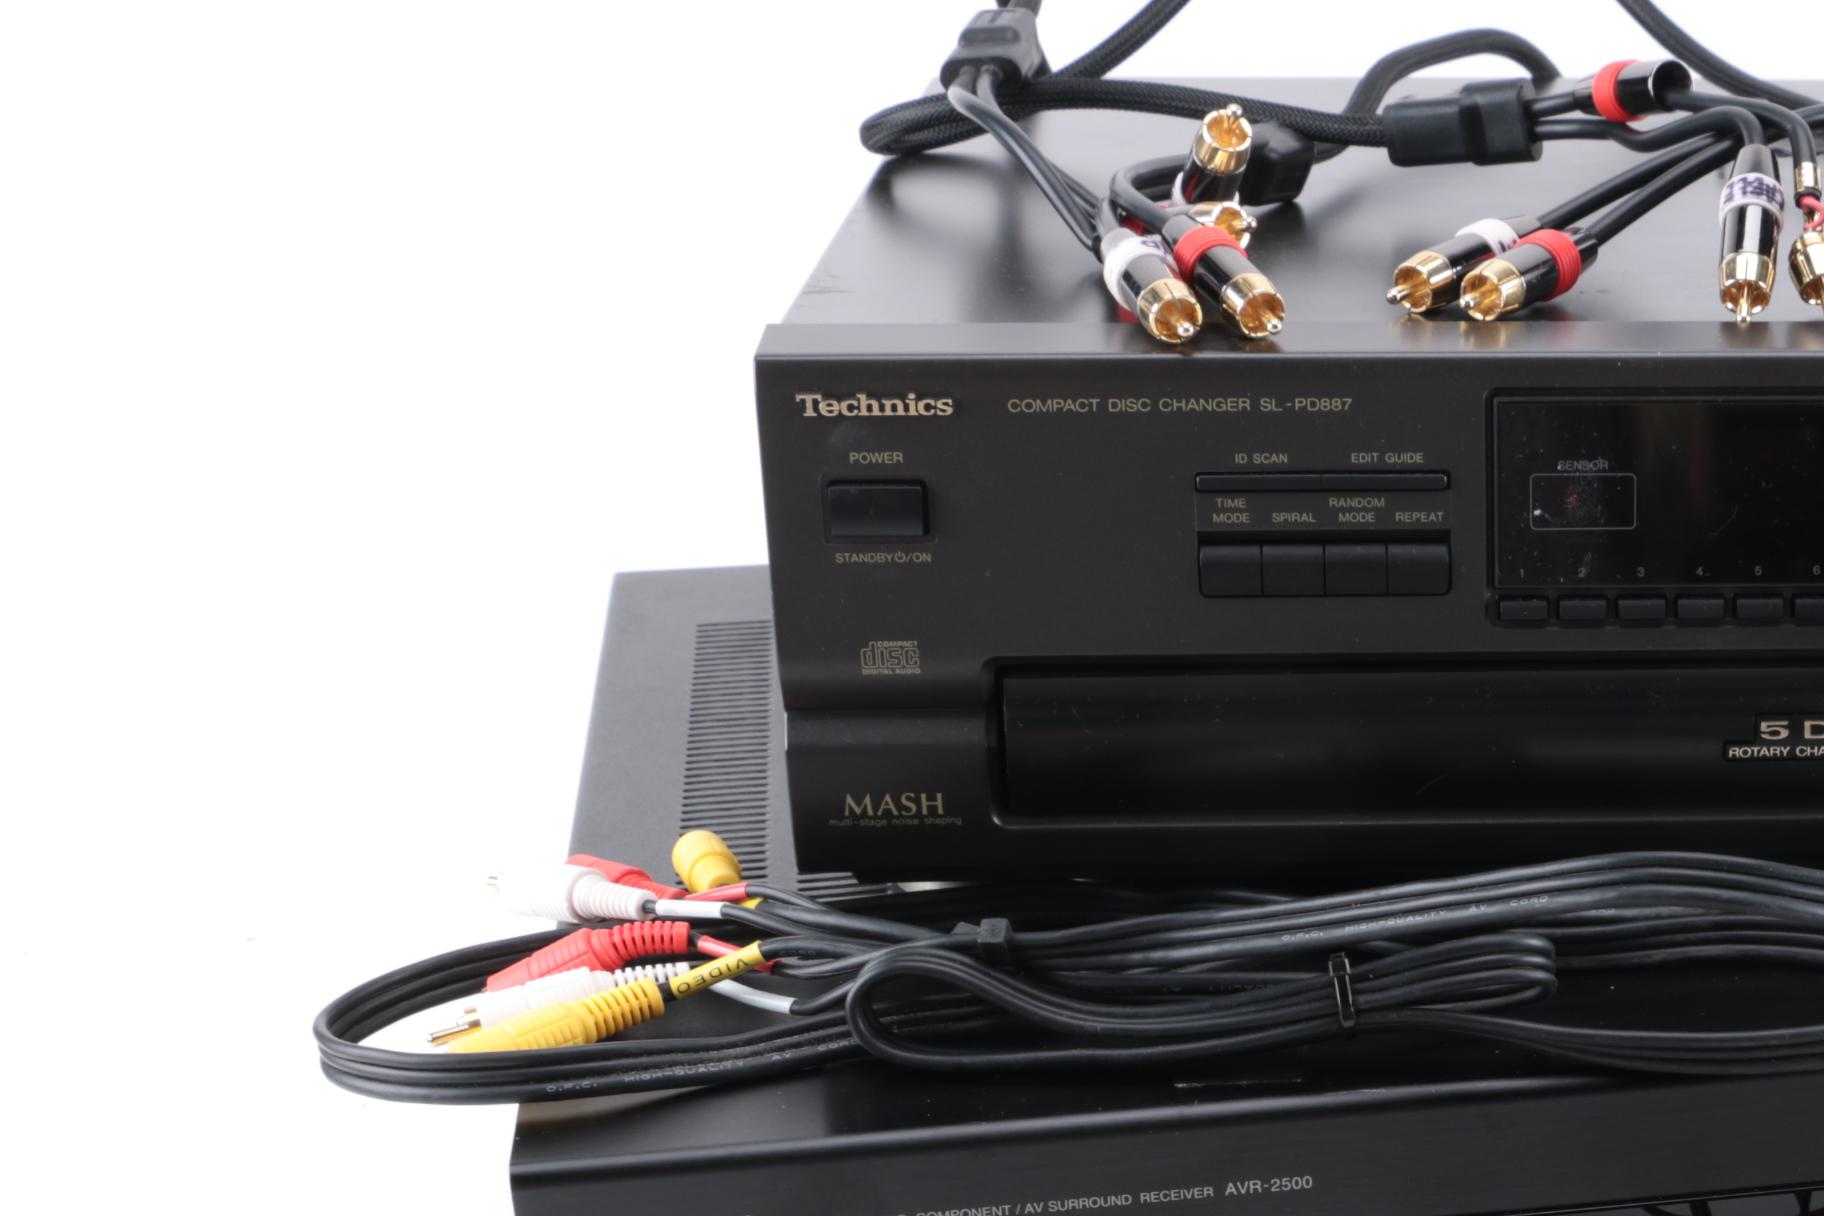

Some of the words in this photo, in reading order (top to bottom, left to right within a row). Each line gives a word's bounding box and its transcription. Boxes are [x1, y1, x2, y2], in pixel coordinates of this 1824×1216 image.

[796, 392, 954, 416] Technics
[1007, 398, 1100, 413] COMPACT
[1108, 398, 1151, 412] DISC
[1159, 397, 1251, 412] CHANGER
[1260, 397, 1352, 412] SL-PD887
[849, 452, 904, 463] POWER
[1235, 453, 1247, 464] ID
[1253, 453, 1288, 464] SCAN
[1351, 452, 1379, 463] EDIT
[1385, 452, 1424, 463] GUIDE
[1216, 498, 1247, 508] TIME
[1329, 497, 1384, 508] RANDOM
[1213, 512, 1250, 523] MODE
[1272, 512, 1316, 522] SPIRAL
[1338, 512, 1376, 523] MODE
[1395, 511, 1444, 522] REPEAT
[1760, 721, 1789, 740] 5
[1729, 746, 1790, 758] ROTARY
[844, 792, 944, 816] MASH
[892, 817, 919, 825] noise
[924, 816, 962, 826] shaping
[677, 958, 749, 994] VIDEO
[1024, 1202, 1044, 1215] AV
[1048, 1194, 1132, 1213] SURROUND
[1140, 1186, 1214, 1203] RECEIVER
[1225, 1175, 1313, 1196] AVR-2500
